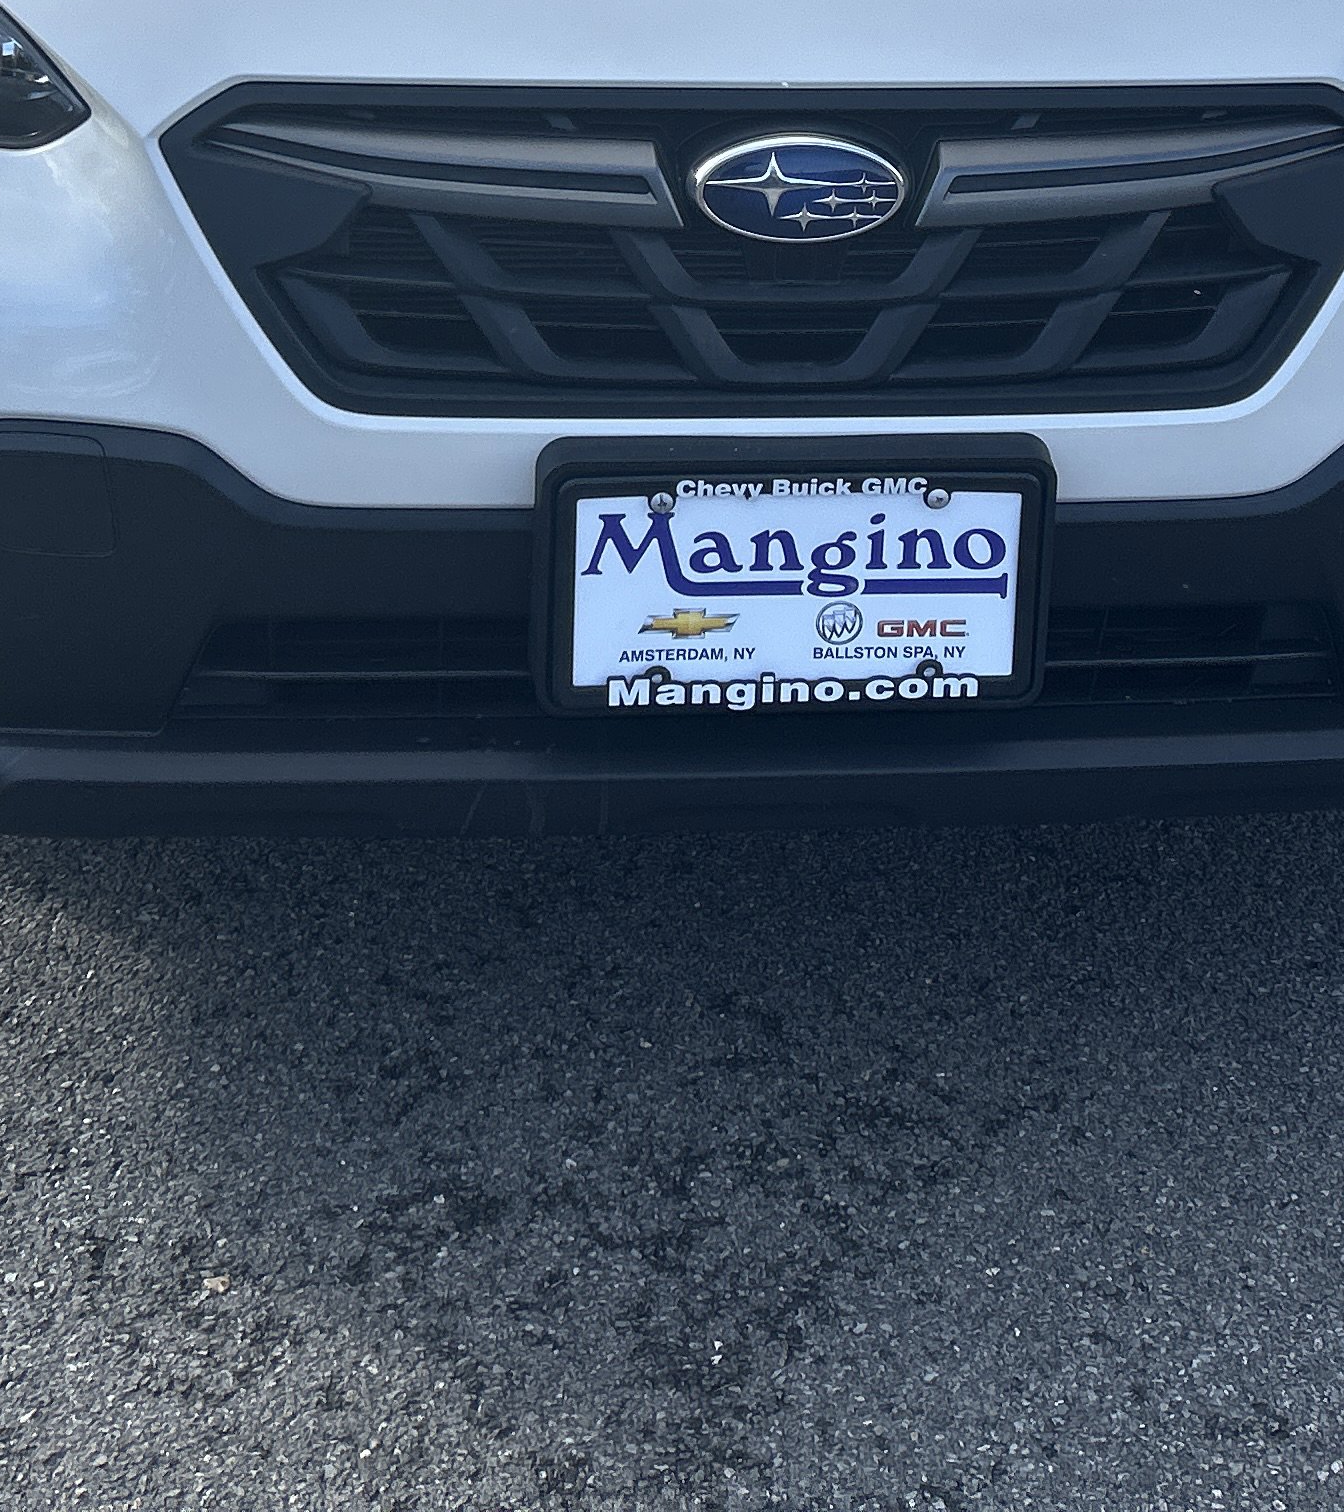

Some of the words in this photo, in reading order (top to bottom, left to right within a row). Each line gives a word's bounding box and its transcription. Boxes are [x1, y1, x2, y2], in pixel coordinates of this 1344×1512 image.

[676, 479, 763, 500] Chevy
[773, 478, 853, 498] Buick
[862, 477, 928, 495] GMC
[581, 513, 1009, 598] Mangino
[877, 619, 967, 637] GMC
[618, 648, 728, 662] AMSTERDAM,
[733, 647, 756, 660] NY
[813, 646, 898, 659] BALLSTON
[903, 646, 939, 660] SPA,
[943, 646, 966, 659] NY
[608, 672, 979, 710] Mangino.com
